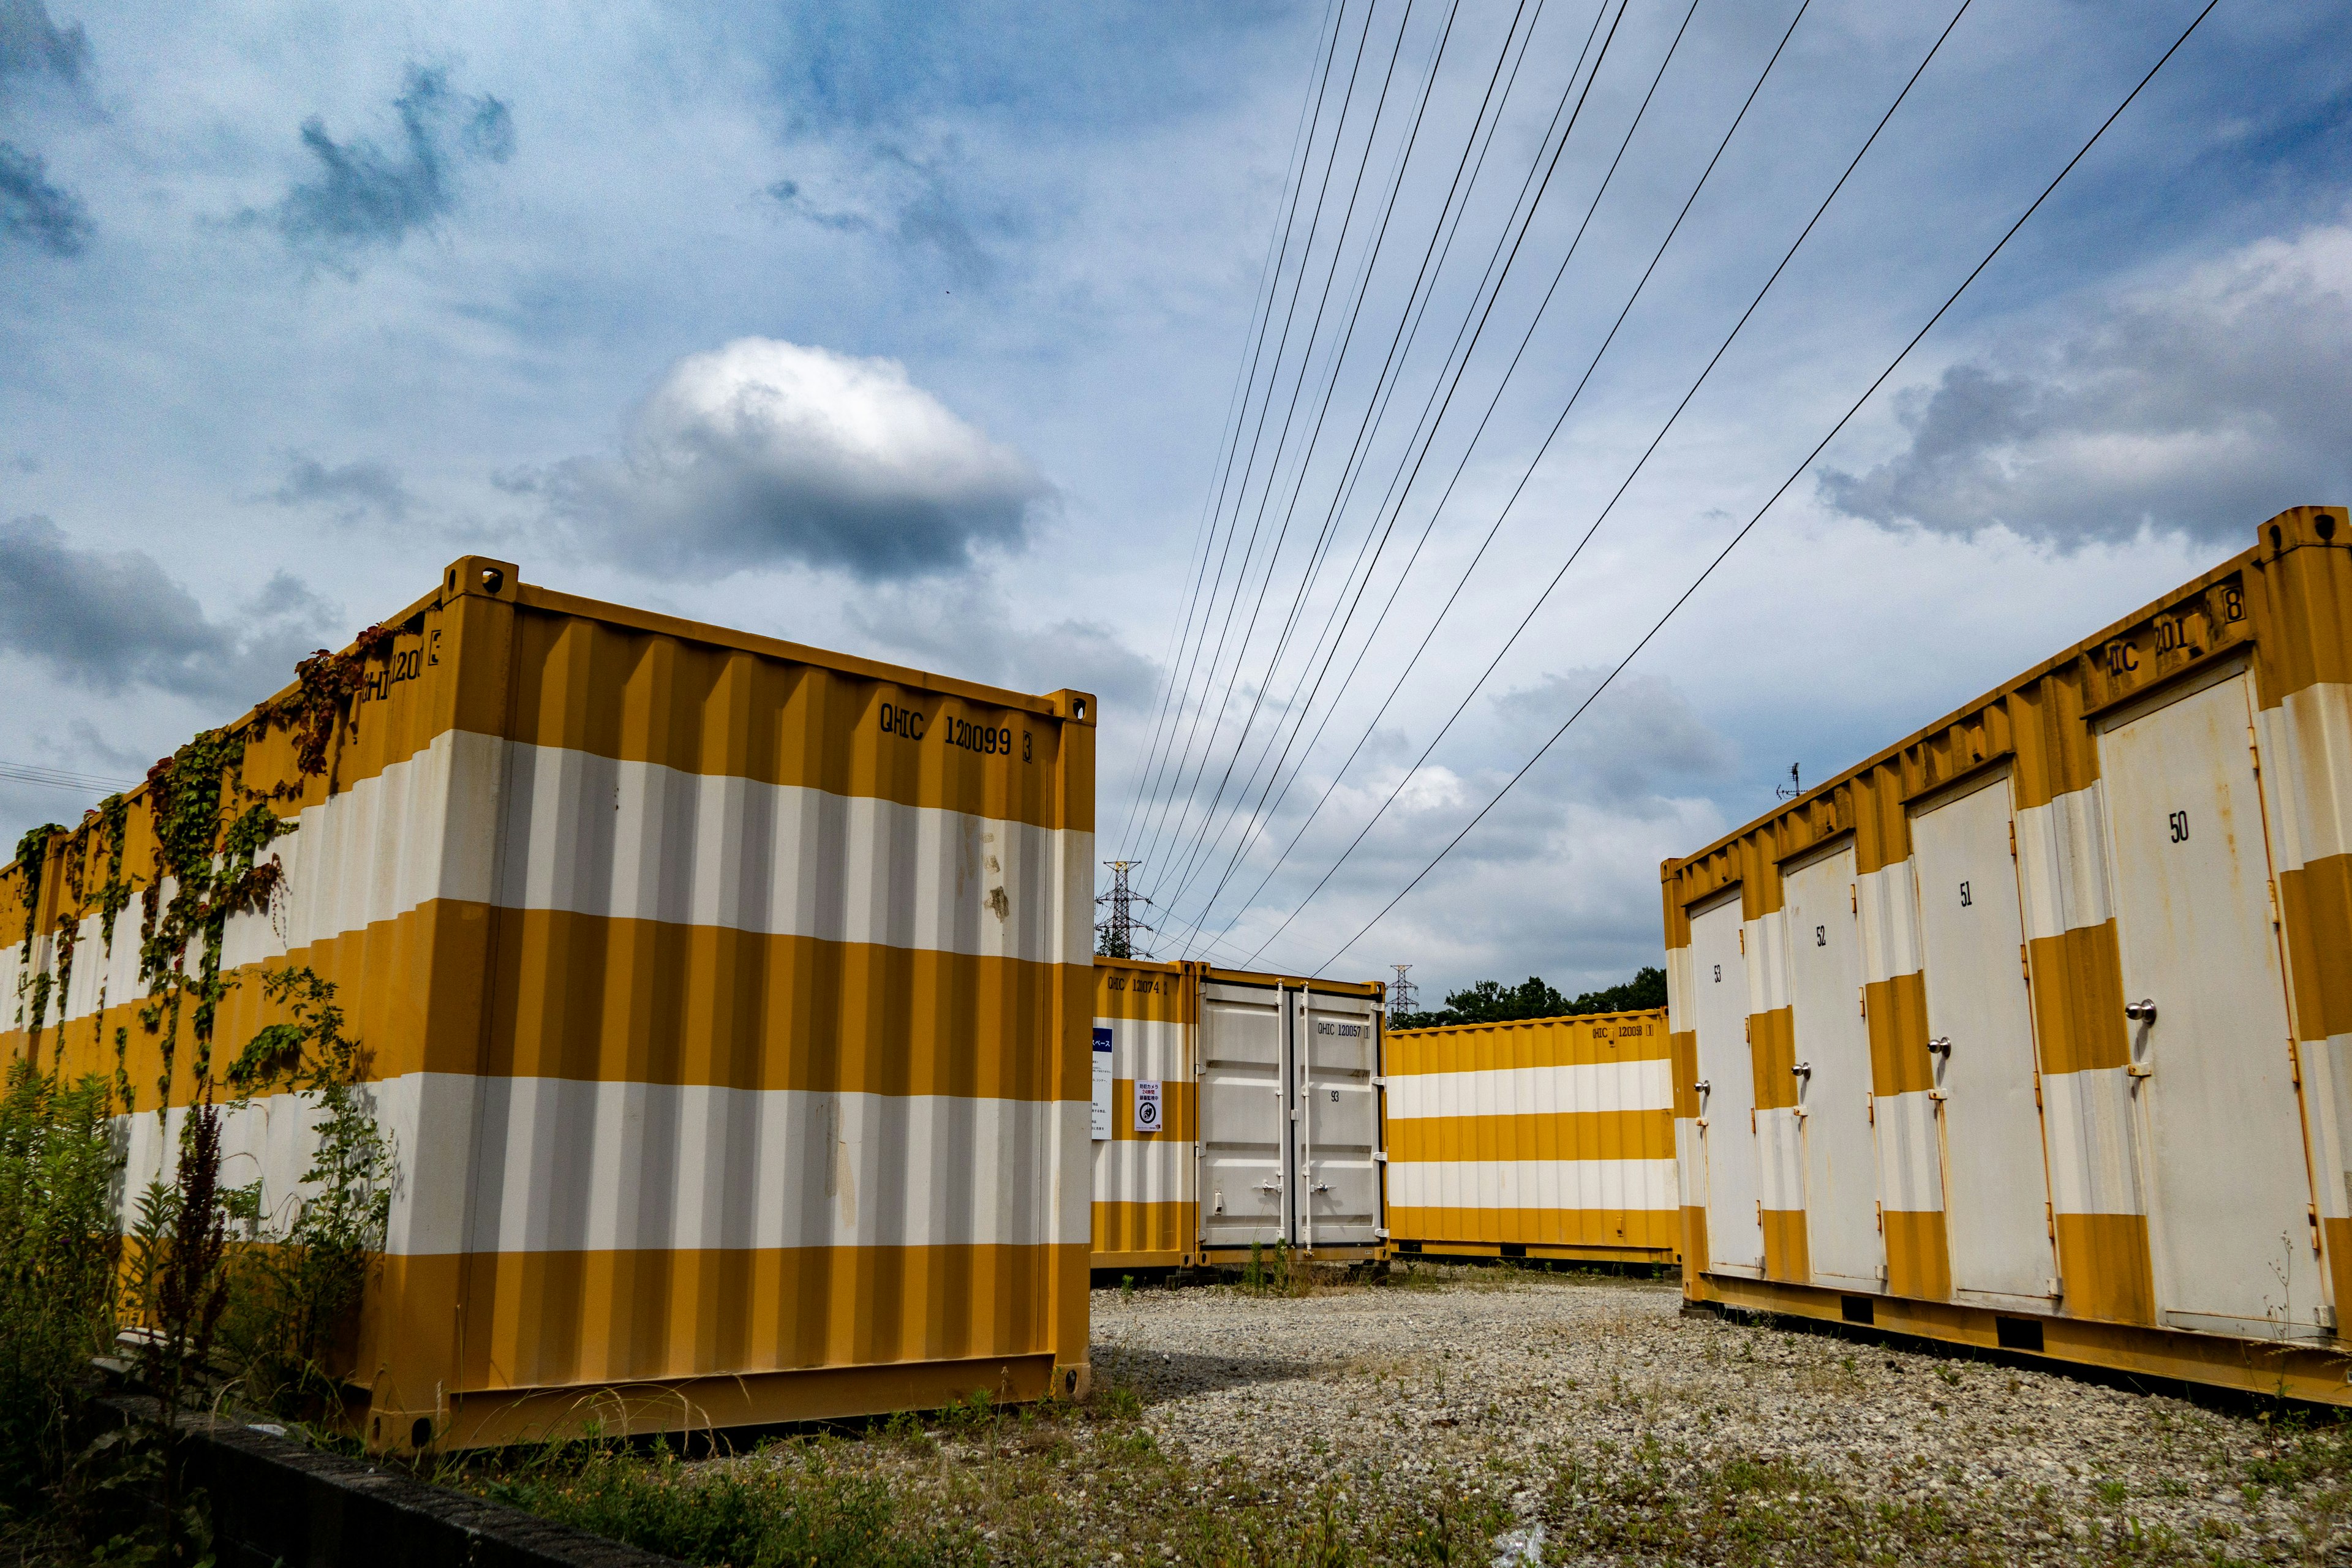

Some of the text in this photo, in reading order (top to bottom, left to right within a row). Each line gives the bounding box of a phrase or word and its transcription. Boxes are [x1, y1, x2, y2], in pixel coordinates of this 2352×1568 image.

[2225, 587, 2243, 621] 8
[880, 703, 1031, 761] QHIC 120099 3
[2169, 810, 2189, 843] 50
[1960, 881, 1972, 907] 51
[1817, 925, 1826, 947] 52
[1714, 964, 1721, 983] 53
[1108, 976, 1125, 991] QHIC
[1133, 979, 1159, 994] 120074
[1318, 1022, 1335, 1035] QHIC
[1338, 1025, 1361, 1038] 120057
[1618, 1025, 1642, 1037] 120058
[1331, 1091, 1340, 1102] 93
